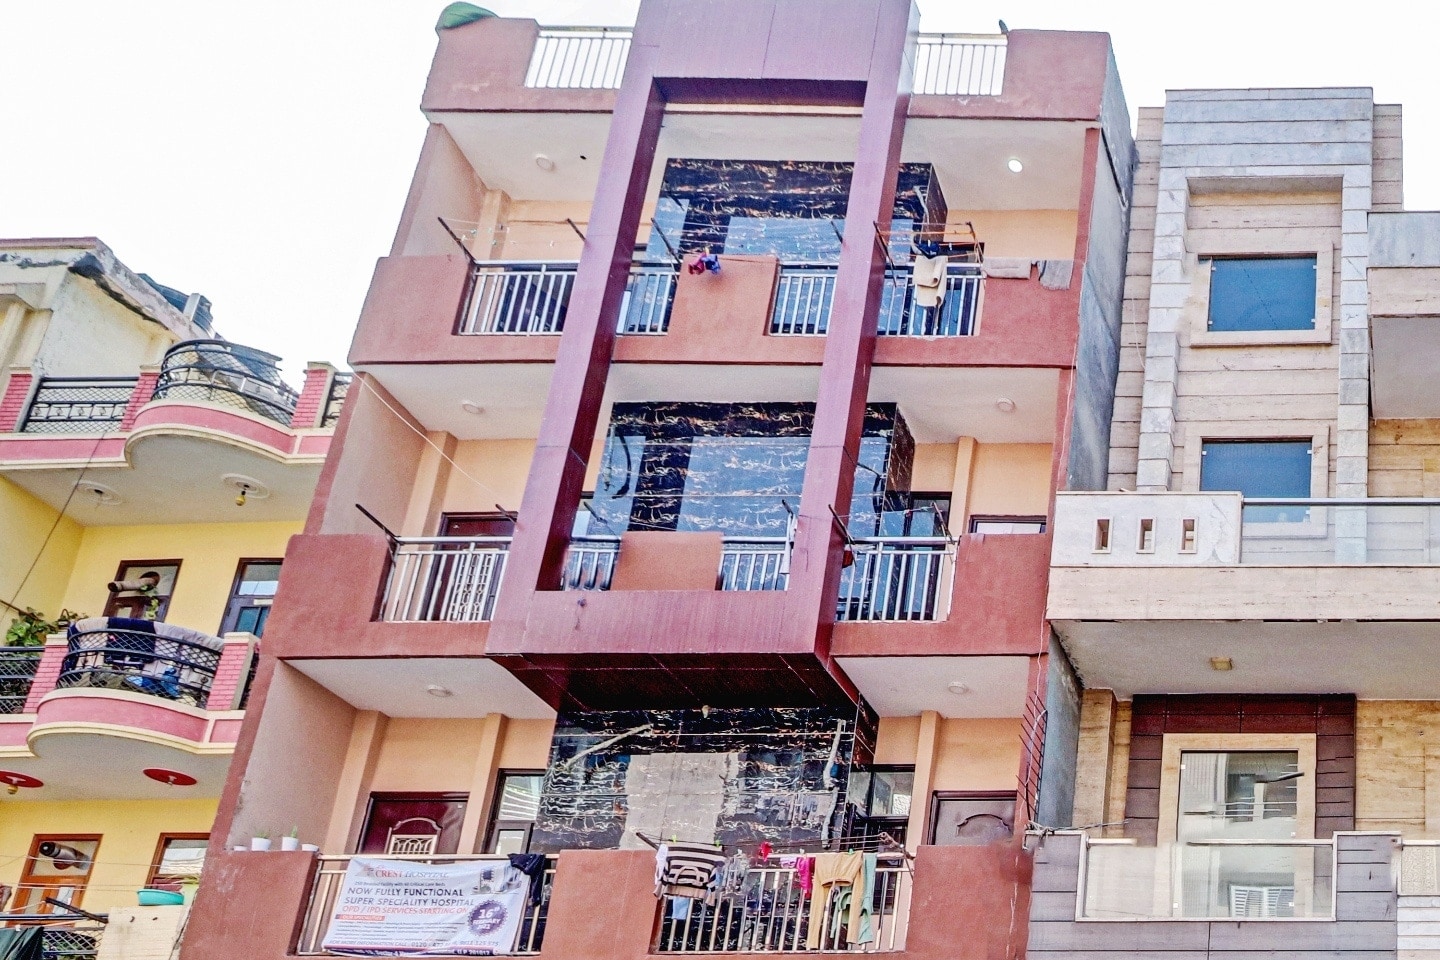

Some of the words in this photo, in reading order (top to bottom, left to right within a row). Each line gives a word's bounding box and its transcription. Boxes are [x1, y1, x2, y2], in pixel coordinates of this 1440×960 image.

[347, 887, 373, 895] NOW
[375, 888, 401, 896] FULLY
[404, 888, 464, 896] FUNCTIONAL
[344, 897, 374, 905] SUPER
[377, 898, 429, 906] SPECIALITY
[431, 898, 475, 907] HOSPITAL
